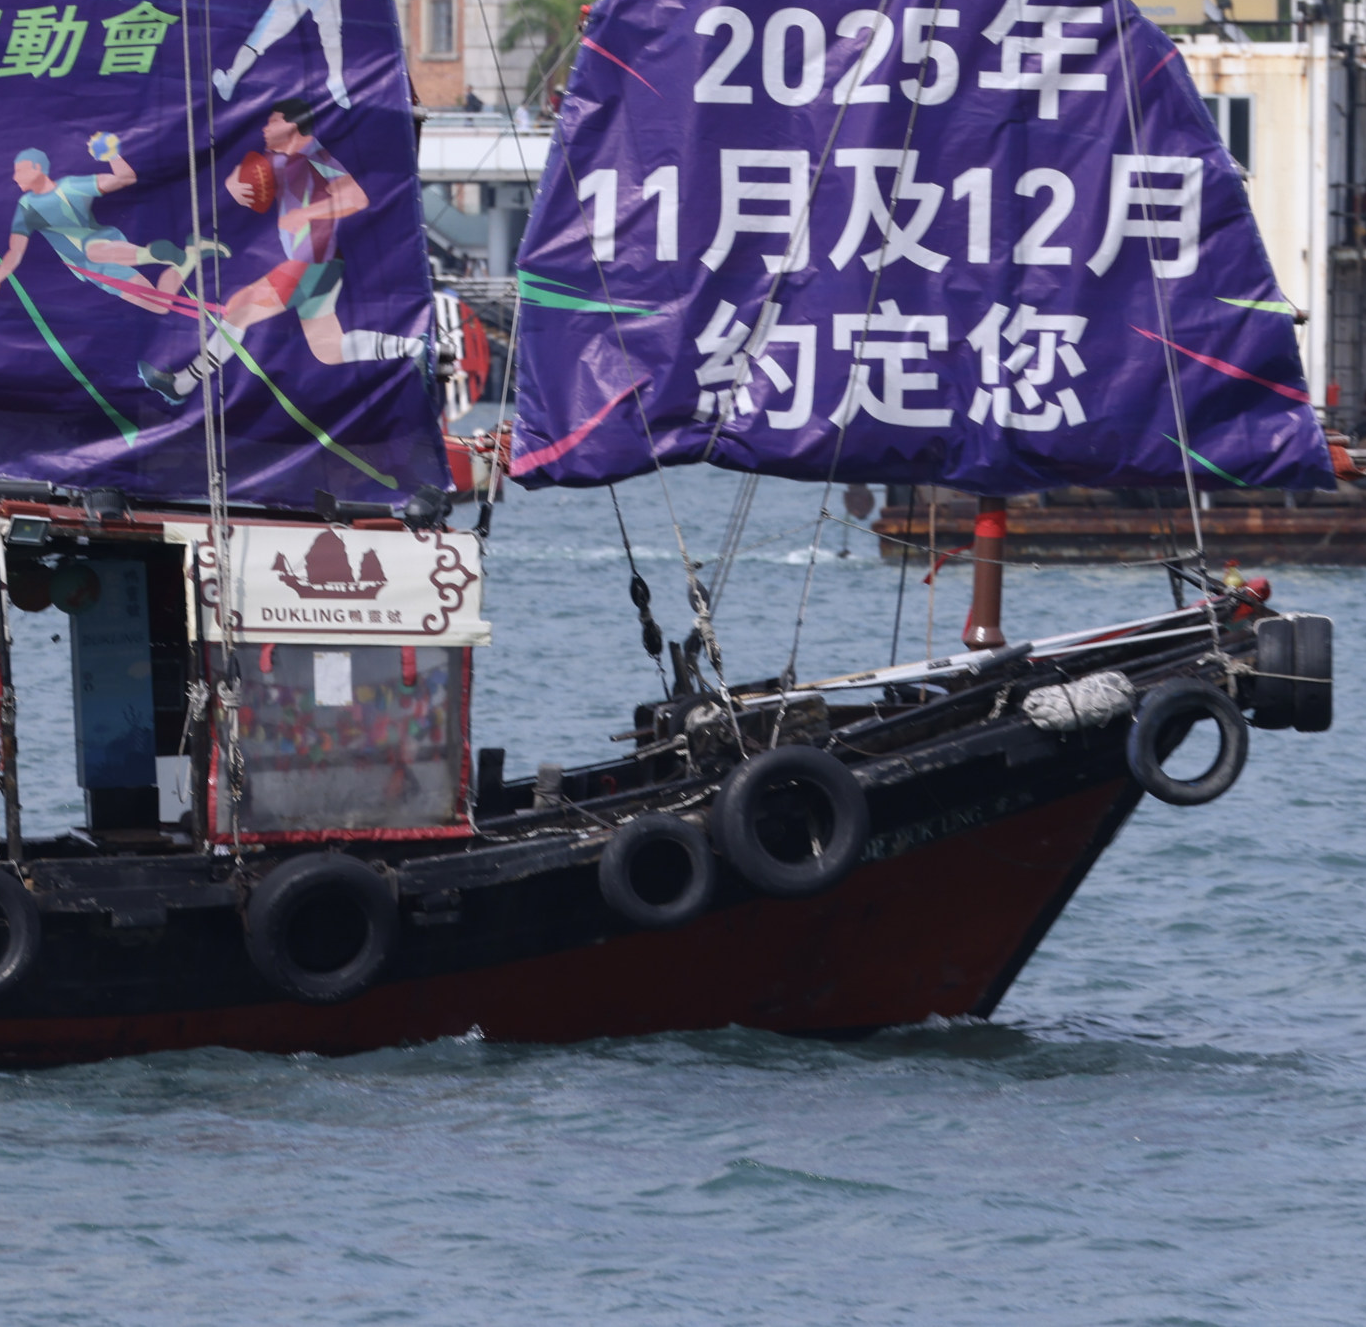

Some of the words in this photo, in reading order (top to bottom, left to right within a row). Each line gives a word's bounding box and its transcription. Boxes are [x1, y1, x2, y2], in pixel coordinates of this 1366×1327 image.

[577, 147, 1204, 279] 11月及12月
[694, 298, 1089, 432] 約定您
[261, 607, 346, 623] DUKLING
[348, 609, 403, 624] 鴨靈號
